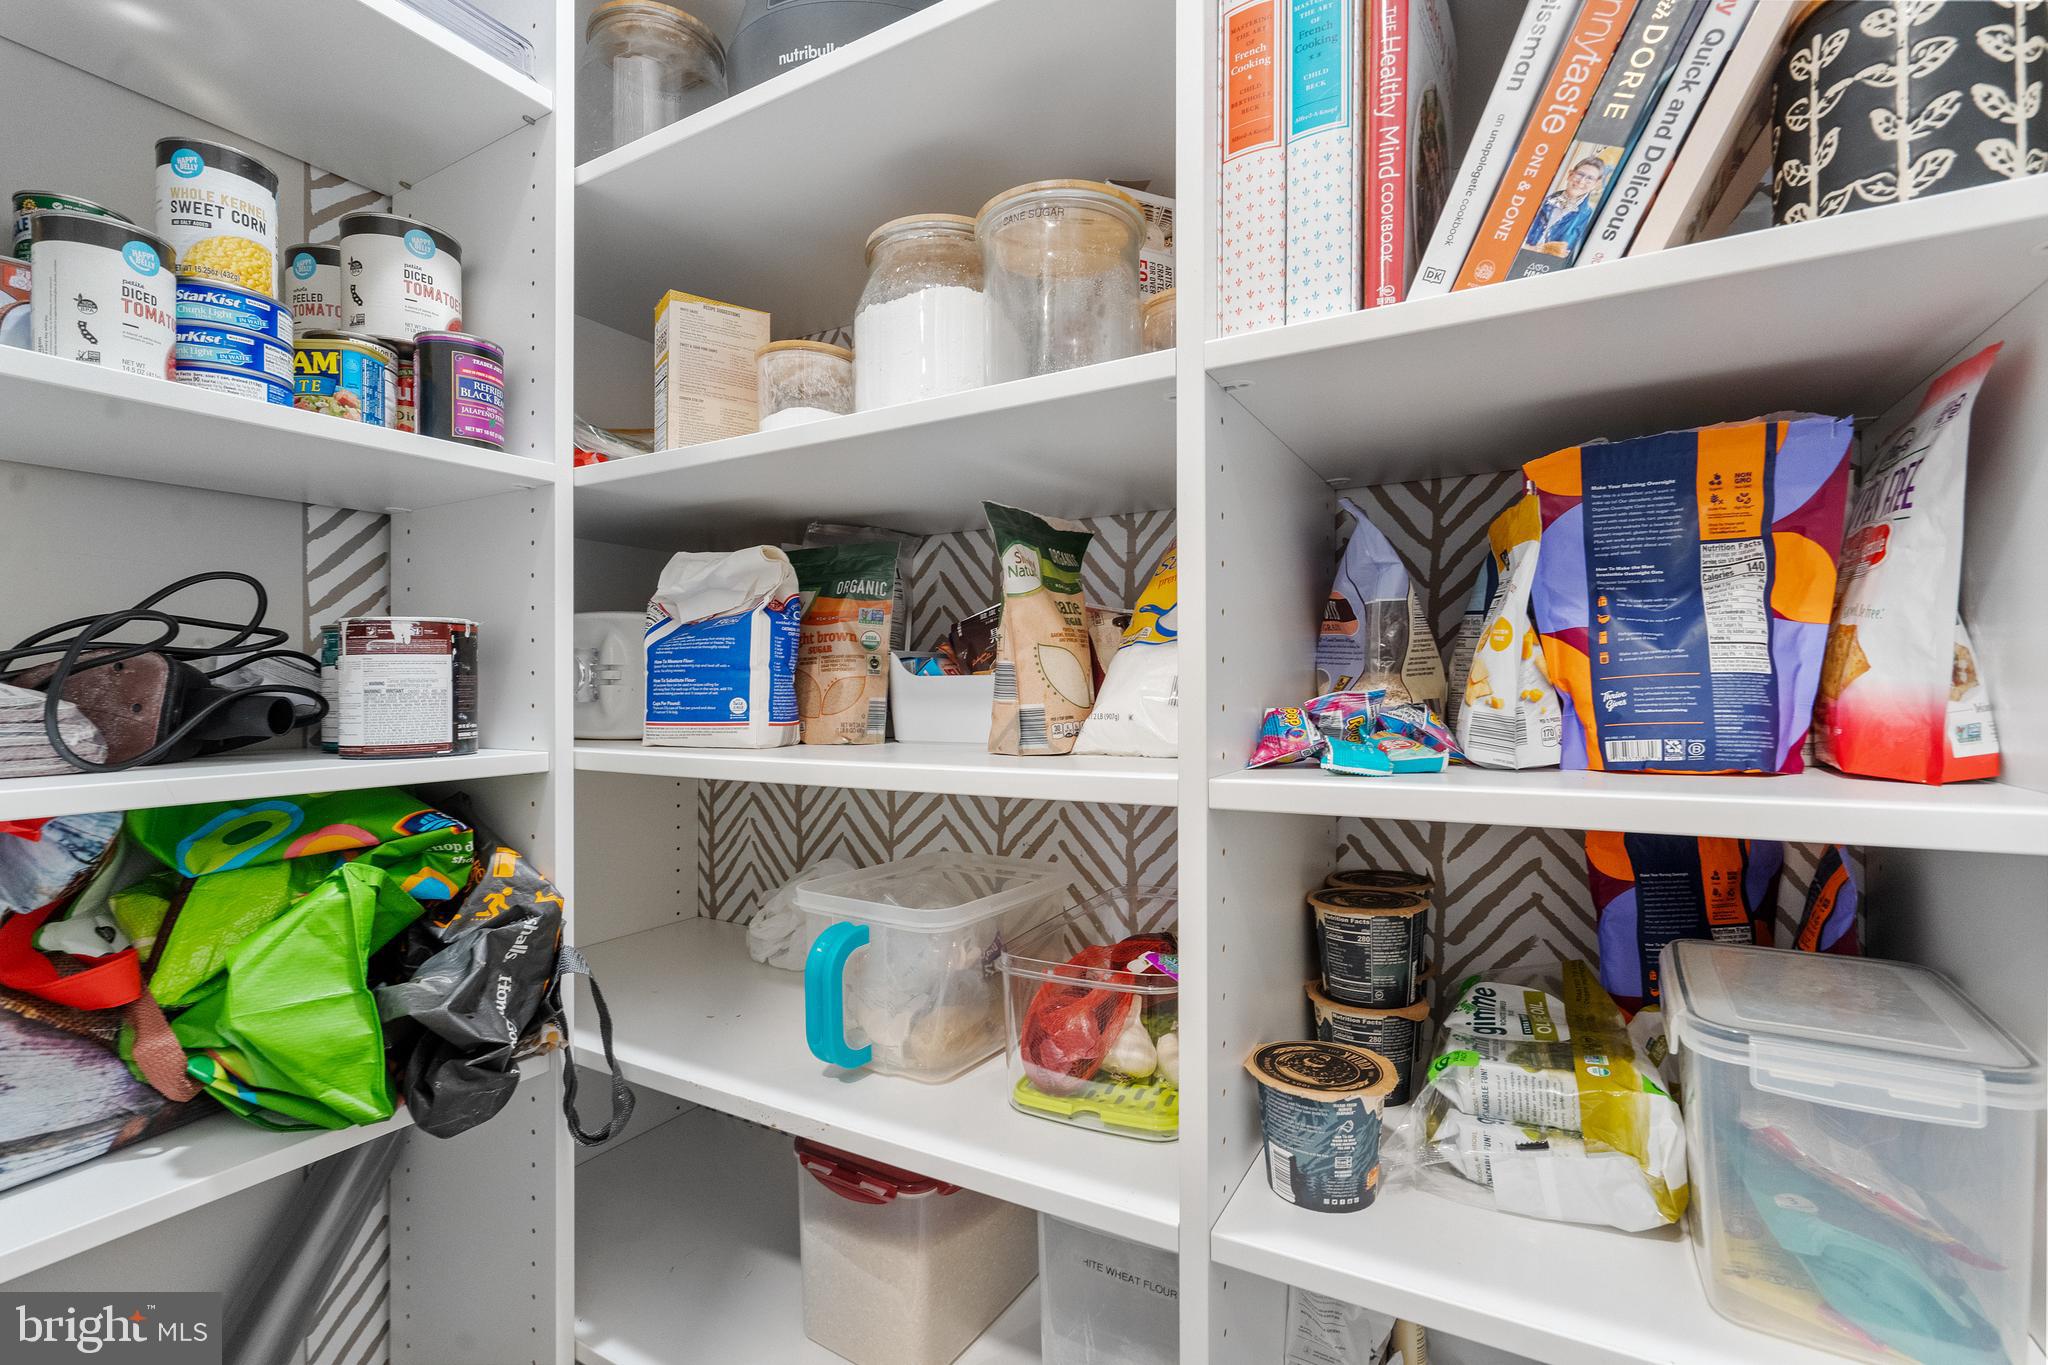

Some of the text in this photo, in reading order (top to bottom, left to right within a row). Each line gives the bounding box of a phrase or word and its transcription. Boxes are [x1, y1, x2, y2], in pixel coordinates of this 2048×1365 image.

[1300, 9, 1315, 19] THE
[1311, 16, 1321, 24] OF
[1384, 5, 1397, 31] THE
[1298, 20, 1333, 40] French
[1234, 42, 1267, 62] French
[1295, 33, 1338, 54] Cooking
[1506, 0, 1562, 91] issman
[779, 42, 850, 66] nutribull
[1231, 55, 1272, 76] Cooking
[1603, 24, 1669, 120] DORIE
[1303, 68, 1329, 81] CHILD
[1374, 35, 1402, 118] Healthy
[1239, 82, 1262, 95] CHILD
[1305, 80, 1327, 92] BECK
[1241, 104, 1260, 115] BECK
[1602, 28, 1726, 242] Quick and Delicious
[1378, 125, 1401, 180] Mind
[1445, 114, 1505, 246] an unapologetic cookbook
[1494, 143, 1549, 241] ONE & DONE
[170, 187, 267, 222] WHOLE KERNEL
[170, 200, 266, 235] SWEET CORN
[1003, 207, 1065, 226] CANE SUGAR
[403, 269, 433, 285] DICED
[1149, 261, 1157, 294] FOR OVER
[1157, 263, 1165, 293] CRAFTE
[1165, 265, 1173, 290] ARTIS
[1425, 270, 1442, 282] DK
[122, 286, 157, 306] DICED
[176, 289, 242, 308] StarKist
[292, 293, 323, 303] PEELED
[403, 279, 462, 313] TOMATOE
[121, 298, 176, 332] TOMATO
[293, 303, 341, 318] TOMATO
[246, 318, 266, 327] WATER
[176, 331, 223, 345] arKist
[122, 358, 146, 369] NET WT
[294, 351, 339, 375] AM
[472, 358, 493, 370] TRADER
[460, 387, 493, 403] BLACK
[474, 381, 504, 398] REFRIED
[1702, 540, 1762, 553] Nutrition Facts
[1746, 561, 1765, 573] 140
[1702, 570, 1735, 582] Calories
[836, 579, 888, 597] ORGANIC
[817, 630, 858, 645] brown
[807, 645, 833, 654] SUGAR
[1542, 729, 1556, 738] 170
[1324, 914, 1370, 925] Nutrition Facts
[503, 918, 540, 963] shalls.
[1357, 934, 1371, 943] 280
[1530, 1001, 1546, 1015] OIL
[1332, 1012, 1382, 1026] Nutrition Facts
[1368, 1035, 1382, 1043] 280
[1082, 1258, 1178, 1300] HITE WHEAT FLOUR
